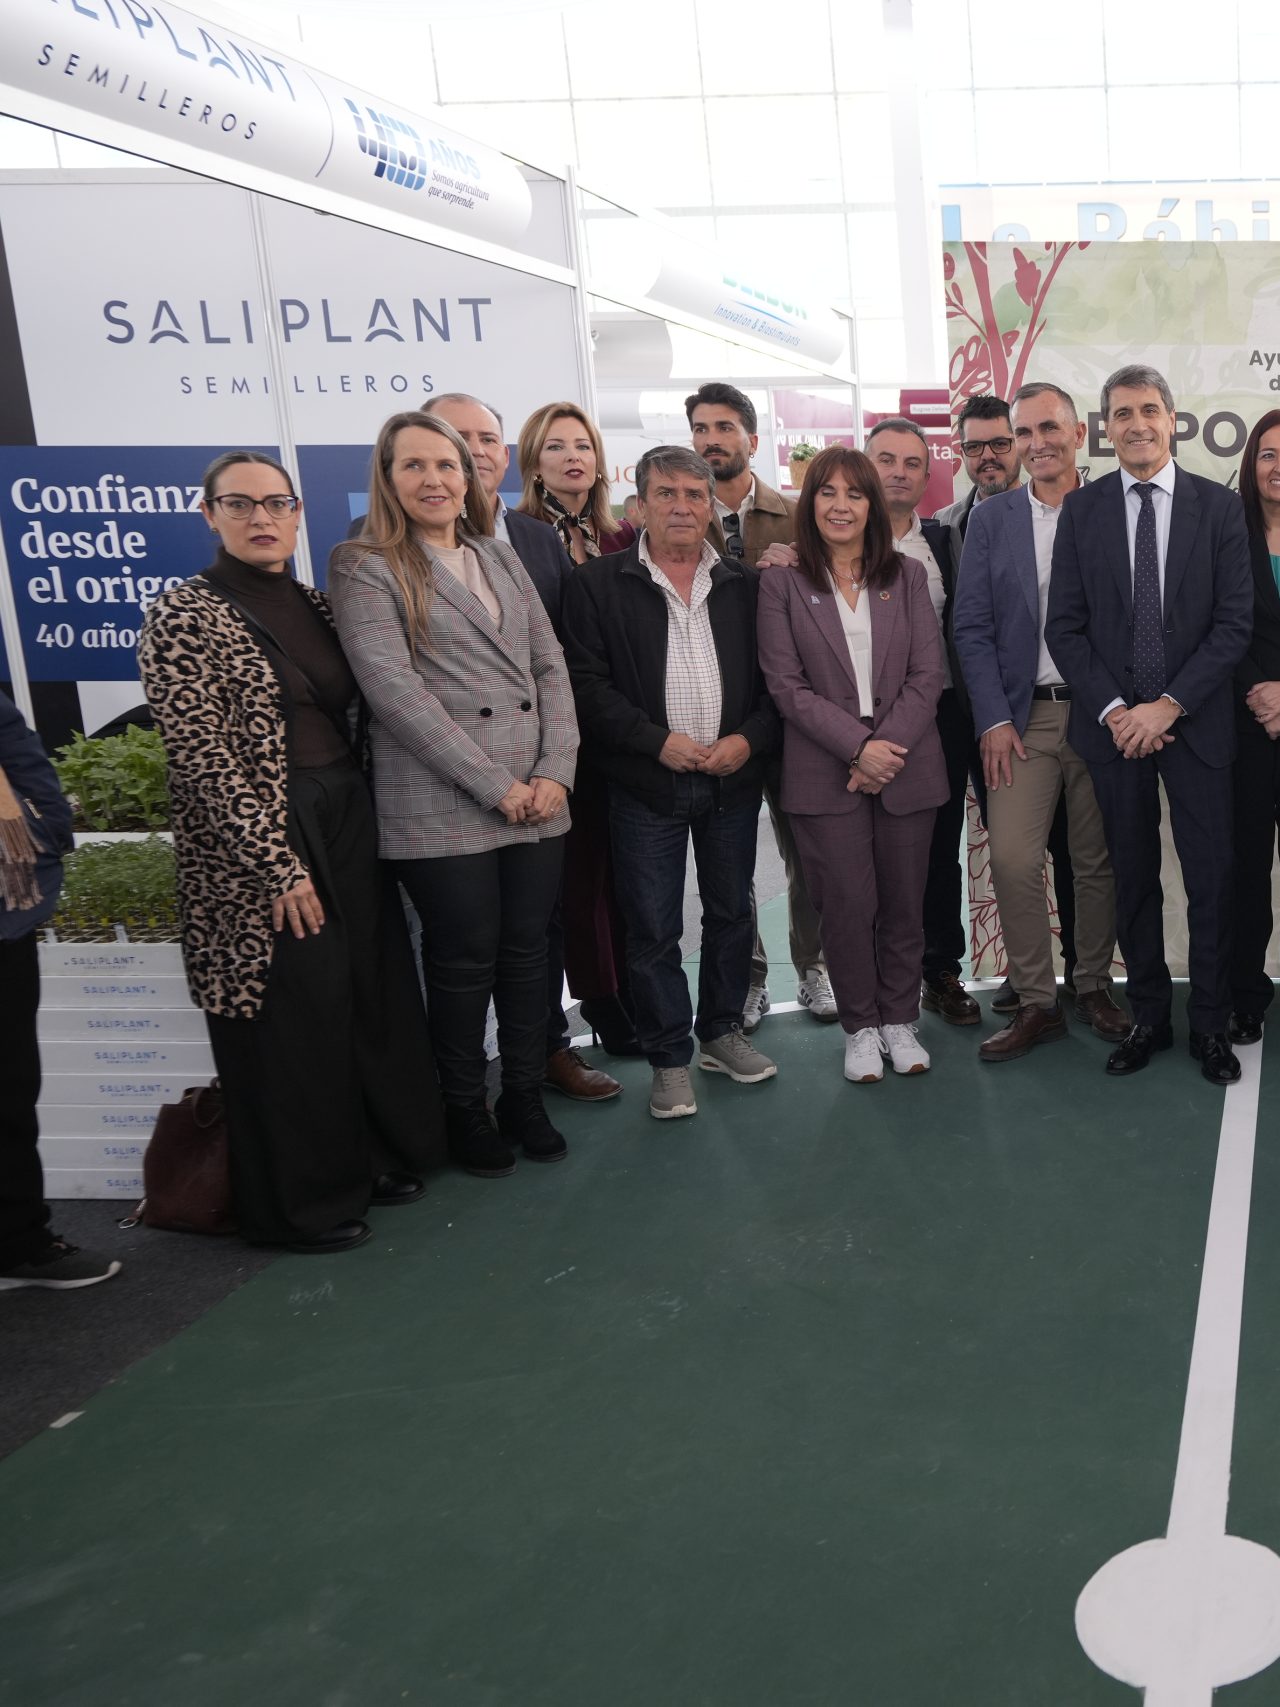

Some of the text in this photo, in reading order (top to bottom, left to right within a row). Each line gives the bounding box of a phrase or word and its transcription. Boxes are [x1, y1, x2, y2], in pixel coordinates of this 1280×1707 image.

[37, 43, 258, 140] SEMILLEROS
[428, 137, 481, 180] AÑOS
[428, 185, 475, 210] que sorprende.
[431, 169, 490, 201] Somos agricultura
[103, 297, 492, 344] SALIPLANT
[713, 303, 752, 327] Innovation
[180, 374, 435, 394] SEMILLEROS
[1087, 411, 1248, 458] EPO
[11, 474, 205, 513] Confianz
[20, 520, 147, 559] desde
[28, 566, 184, 613] el orig
[36, 623, 75, 648] 40
[102, 1115, 157, 1123] SALIPLAN
